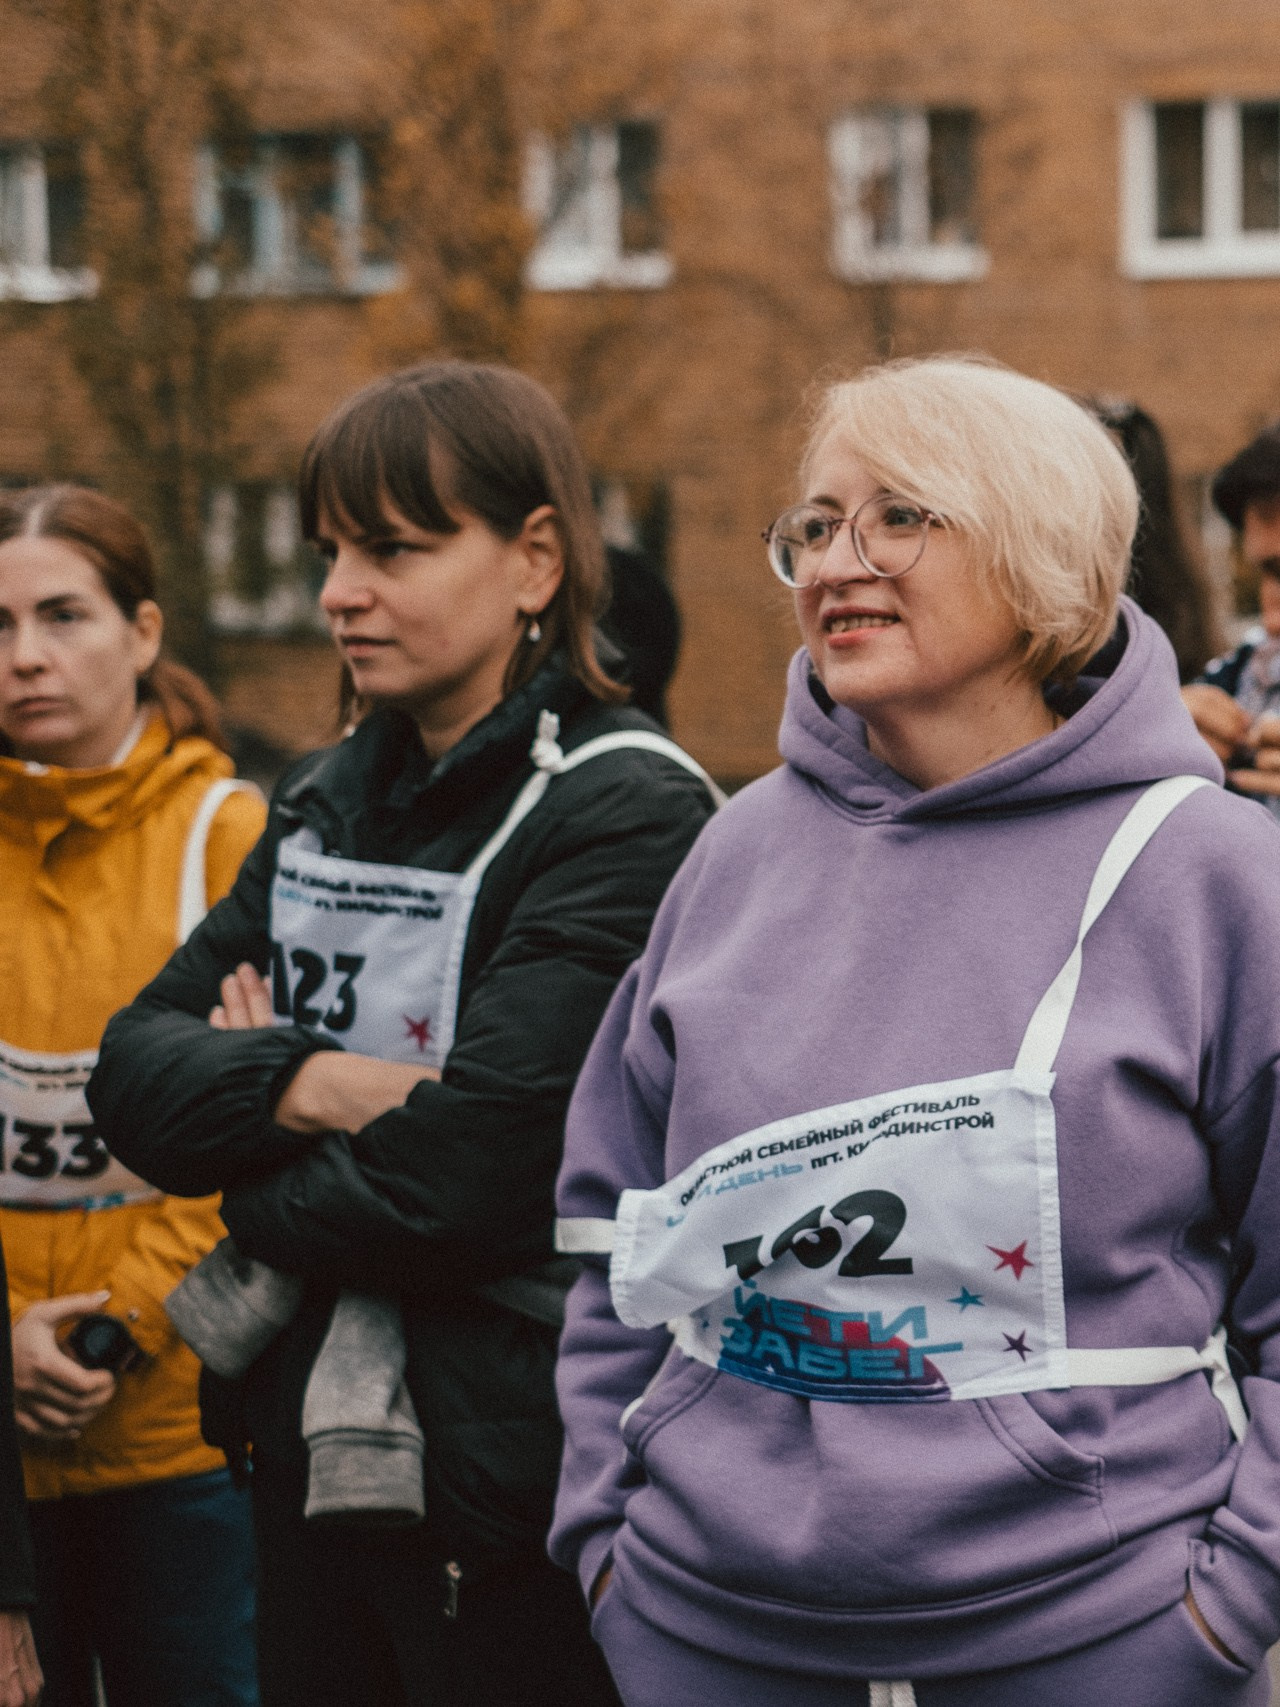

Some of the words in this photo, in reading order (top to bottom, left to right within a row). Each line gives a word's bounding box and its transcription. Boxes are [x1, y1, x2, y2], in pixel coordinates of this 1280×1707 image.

[271, 941, 366, 1031] 123
[757, 1119, 863, 1160] СЕМЕЙНЫЙ
[868, 1094, 981, 1130] ФЕСТИВАЛЬ
[848, 1111, 995, 1159] КИДИНСТРОЙ
[734, 1279, 928, 1343] ЙЕТИ
[720, 1317, 964, 1379] ЗАБЕГ
